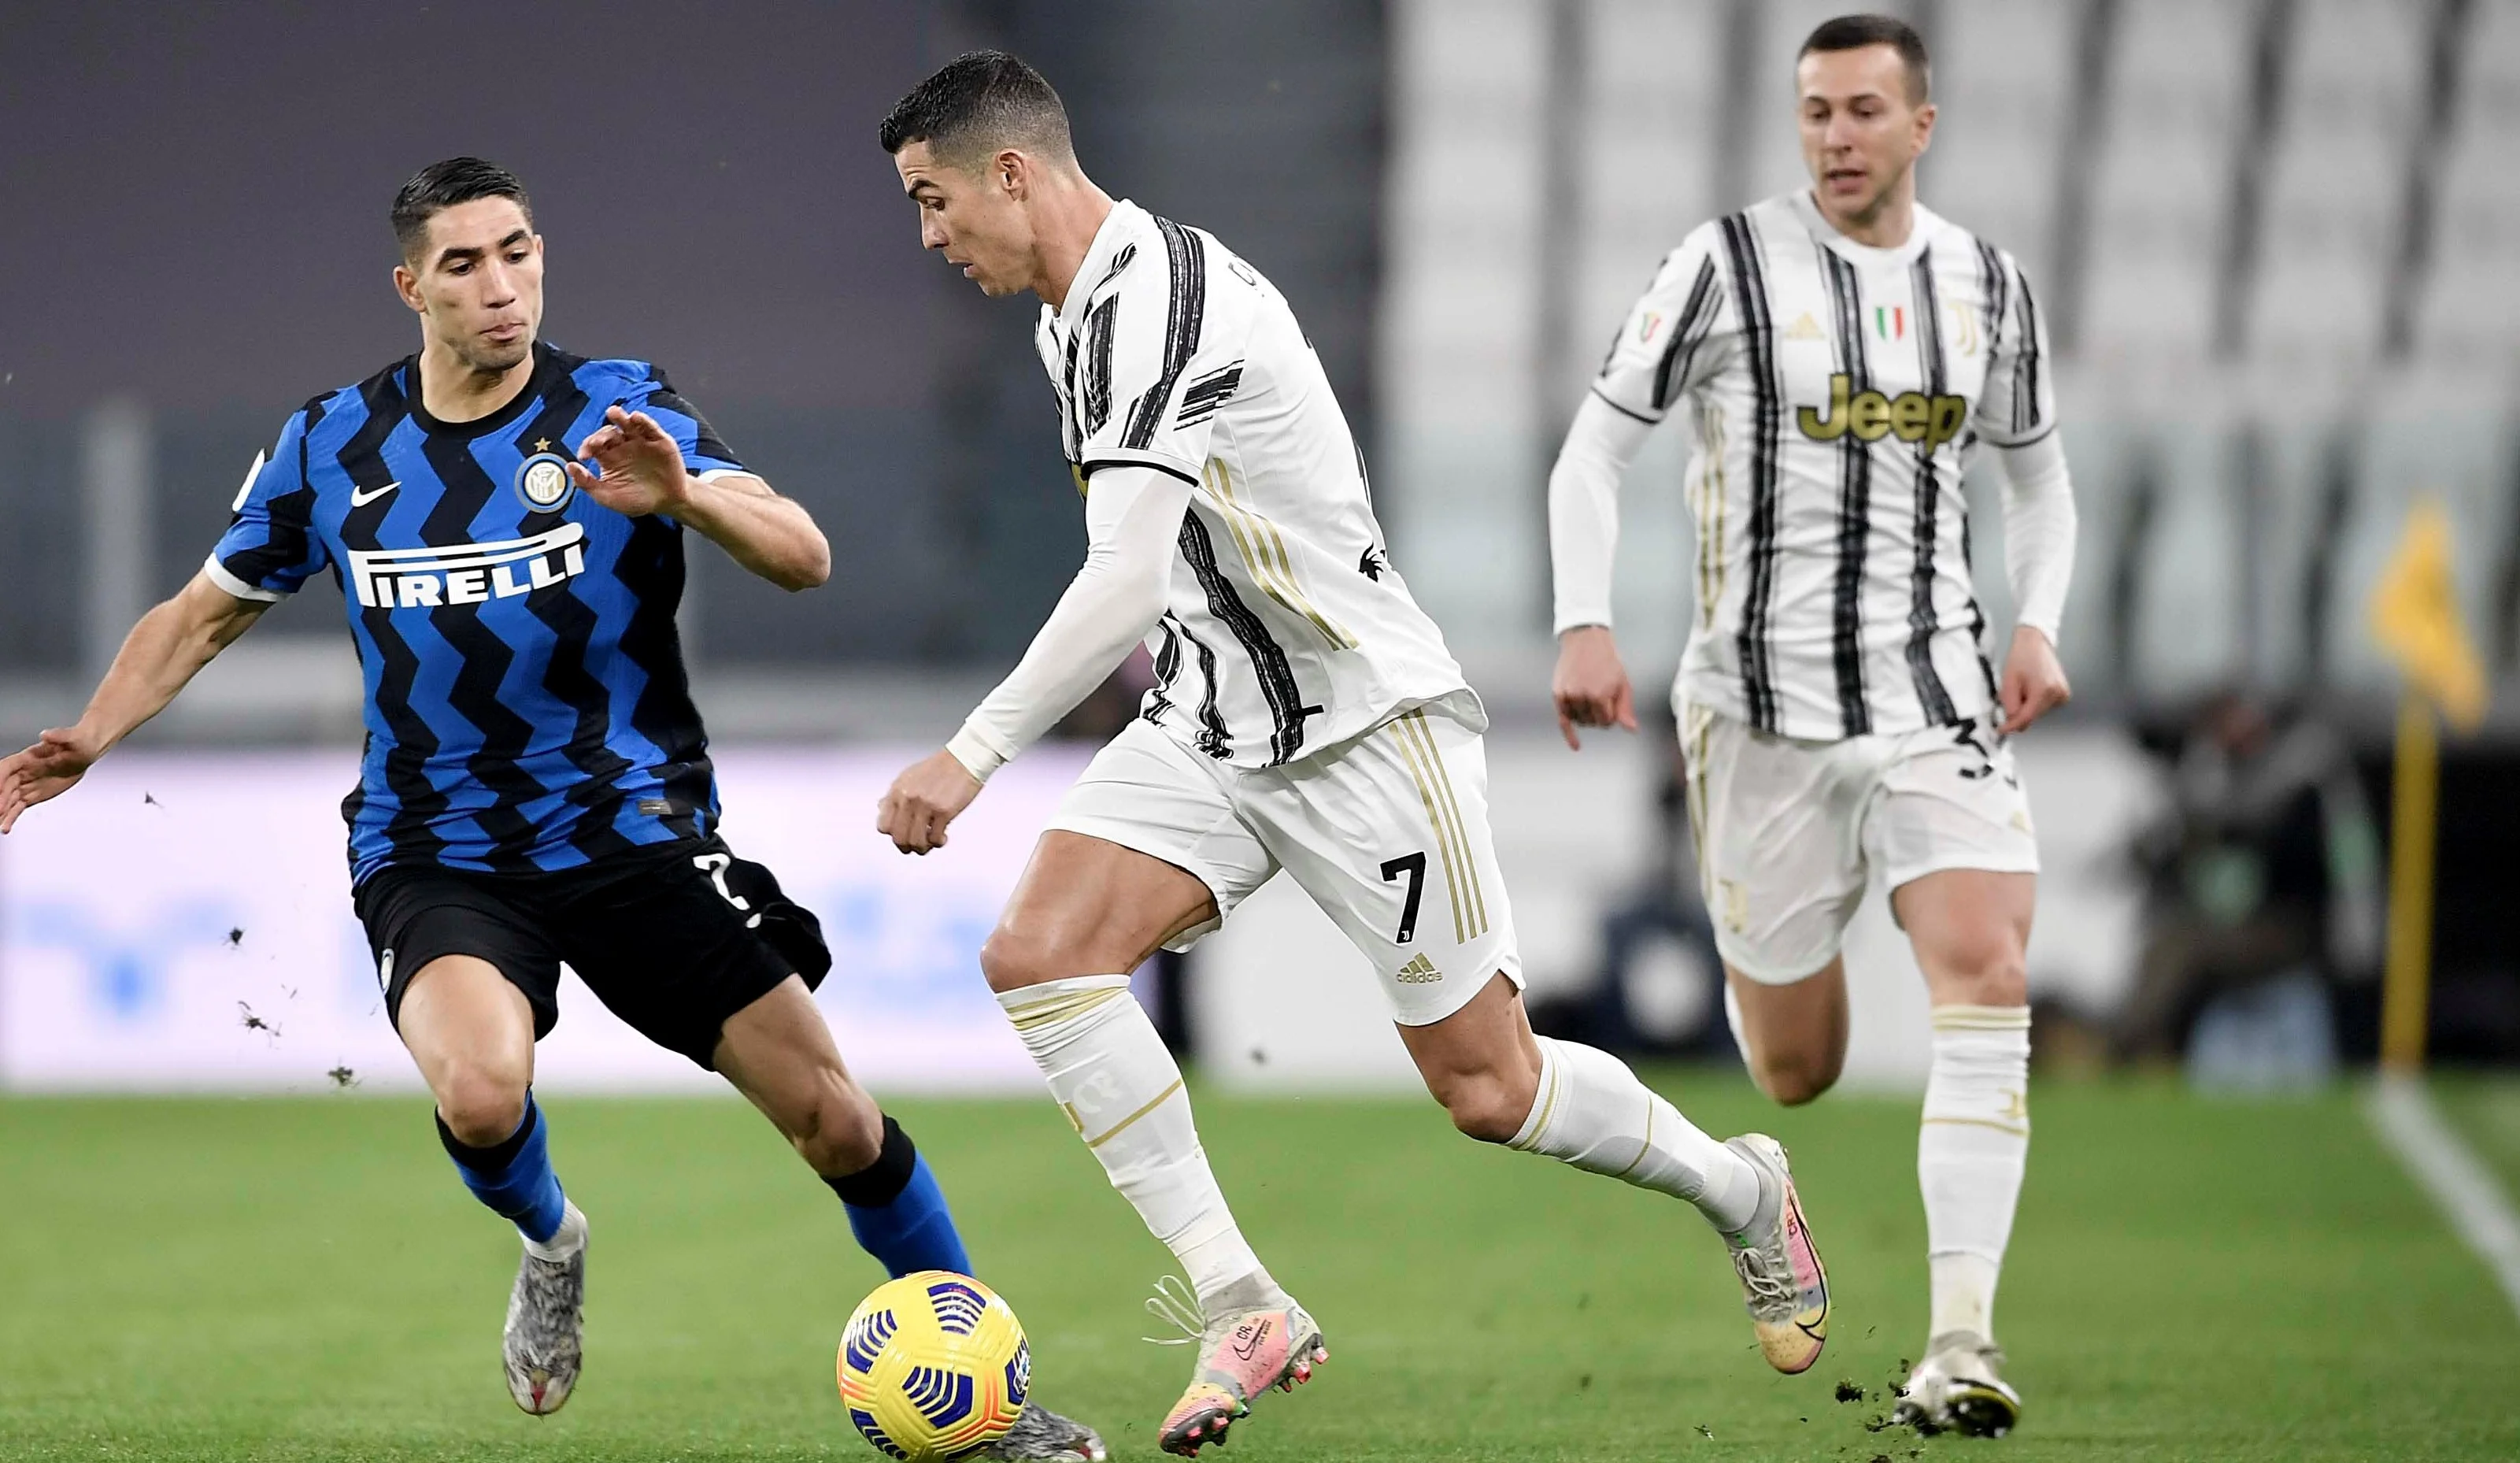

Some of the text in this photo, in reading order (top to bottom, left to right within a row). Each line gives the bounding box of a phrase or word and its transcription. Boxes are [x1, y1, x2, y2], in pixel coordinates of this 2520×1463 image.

[1797, 372, 1967, 457] Jeep
[346, 521, 585, 609] PIRELLI
[1379, 851, 1427, 944] 7
[1397, 971, 1443, 983] adidas
